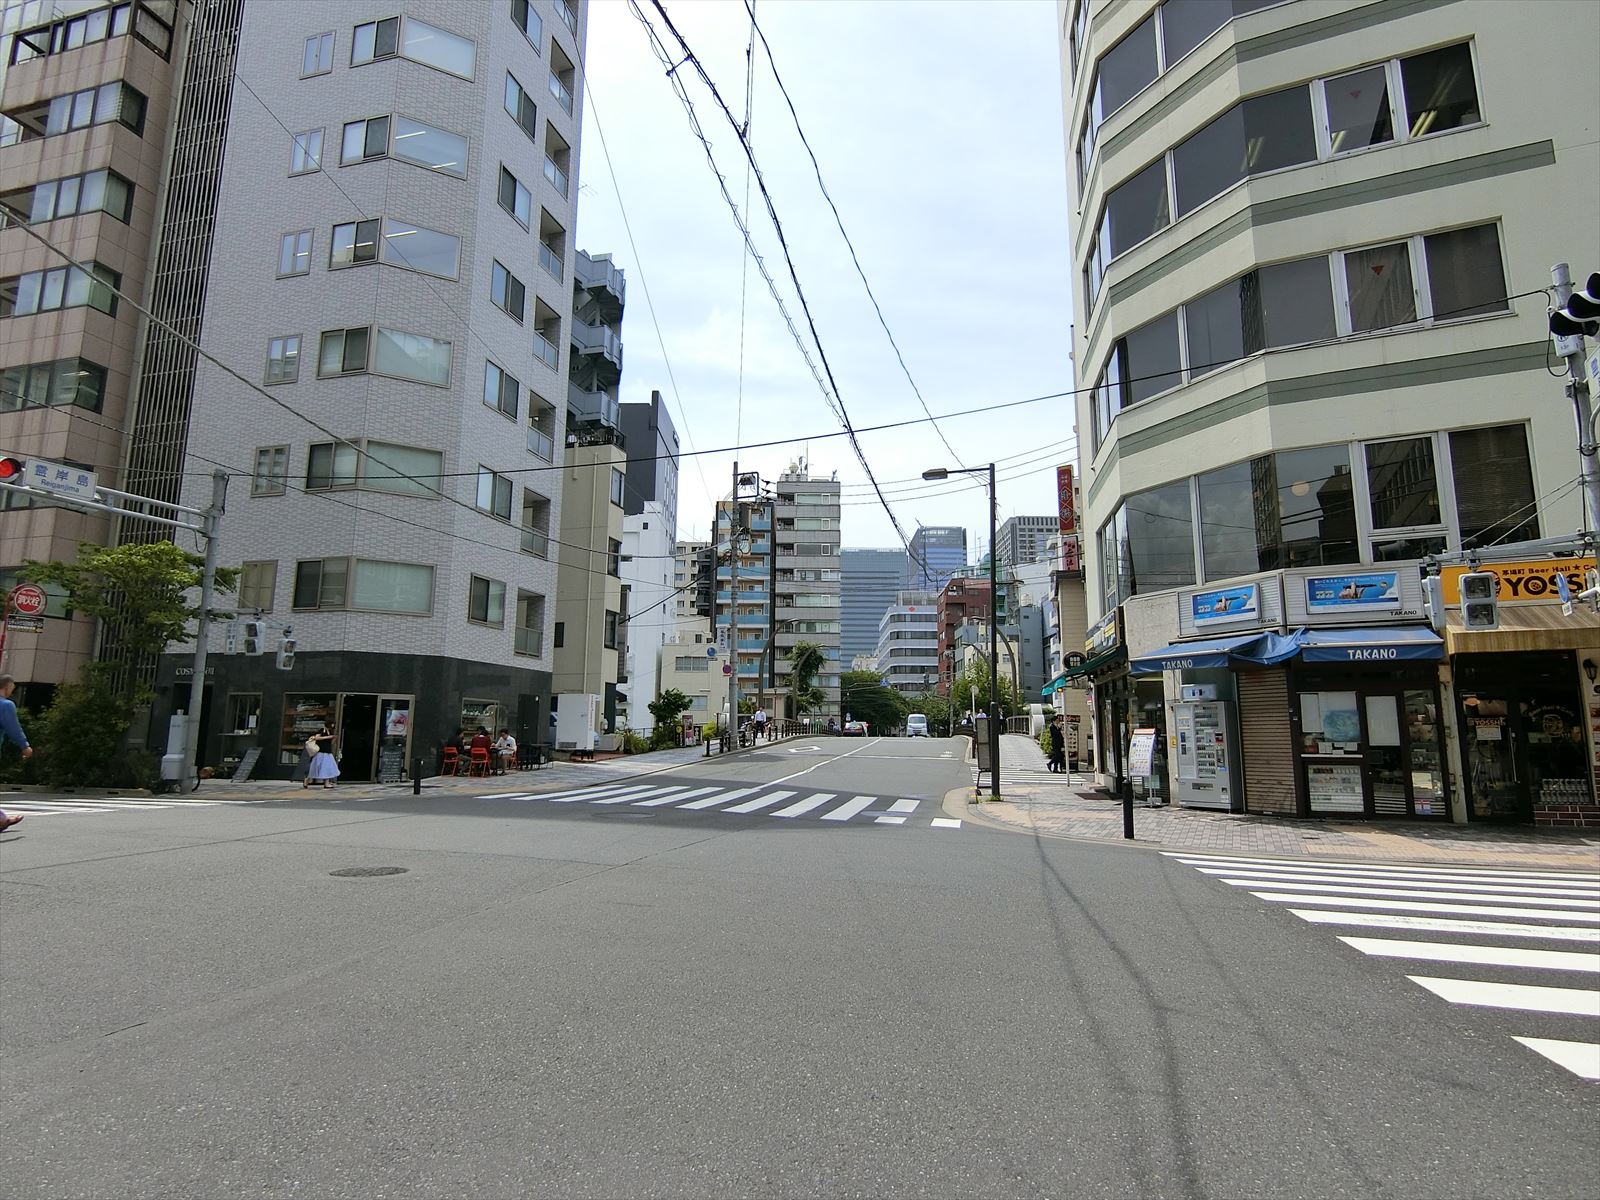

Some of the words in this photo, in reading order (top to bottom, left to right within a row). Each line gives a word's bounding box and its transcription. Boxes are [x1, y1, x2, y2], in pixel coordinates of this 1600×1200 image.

[41, 478, 80, 493] Reiganjima
[1347, 648, 1397, 660] TAKANO
[1161, 659, 1193, 670] TAKANO
